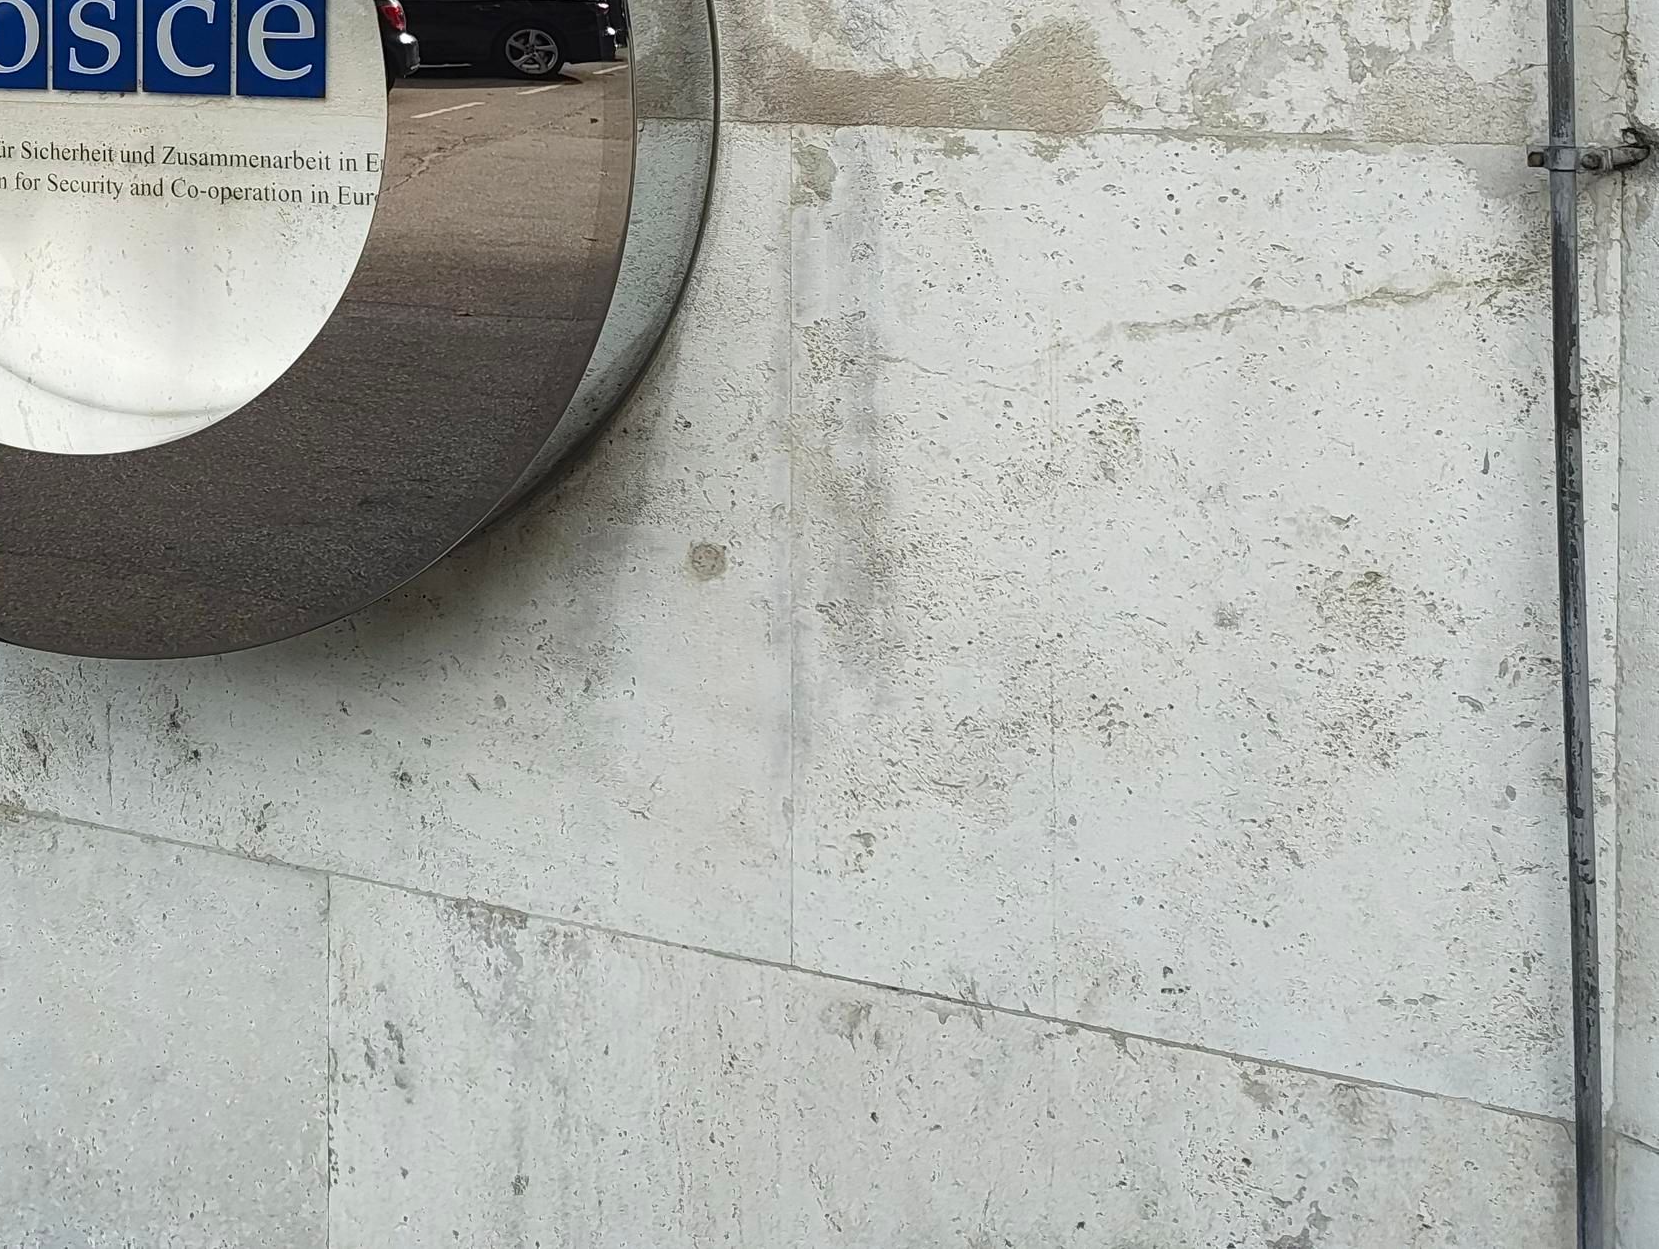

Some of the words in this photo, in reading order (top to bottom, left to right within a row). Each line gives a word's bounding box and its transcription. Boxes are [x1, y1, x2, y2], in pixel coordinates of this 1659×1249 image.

[20, 140, 114, 163] Sicherheit
[120, 146, 155, 165] und
[161, 146, 331, 171] Zusammenarbeit
[339, 151, 358, 172] in
[14, 171, 41, 191] for
[47, 173, 124, 200] Security
[130, 177, 164, 197] and
[171, 178, 303, 205] Co-operation
[311, 184, 330, 204] in
